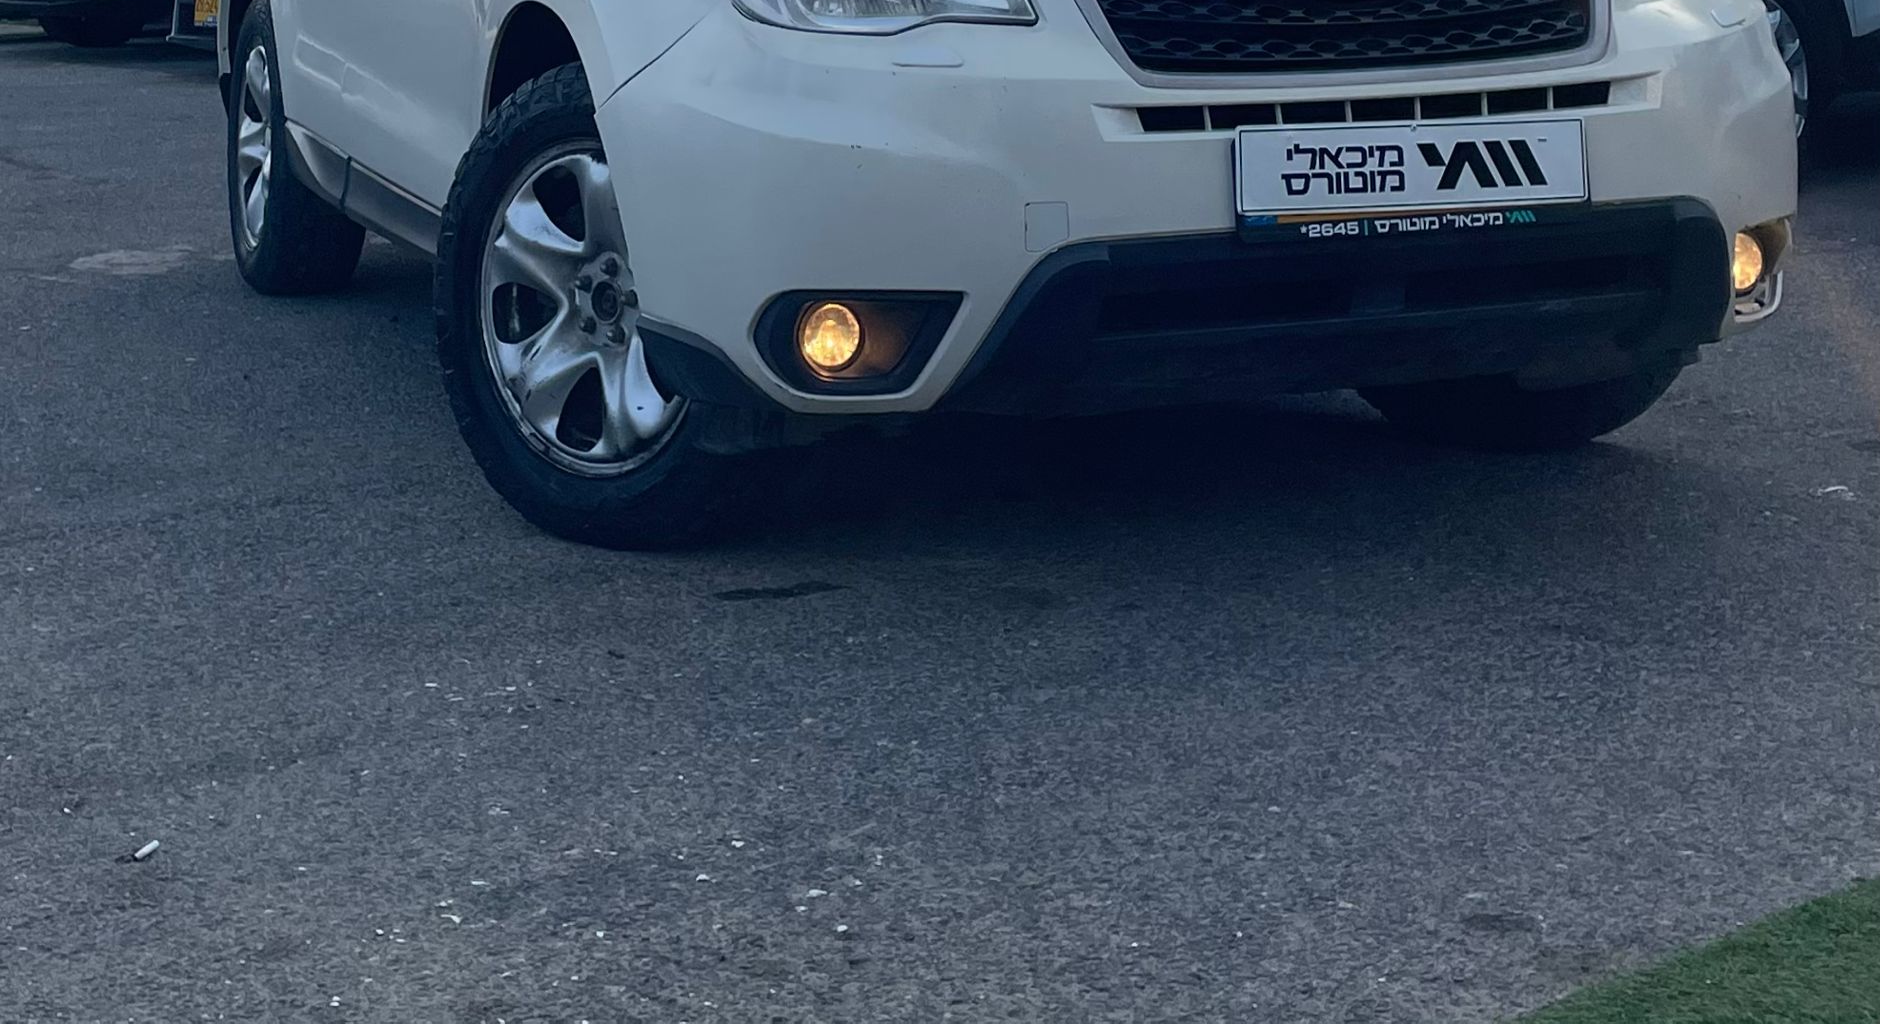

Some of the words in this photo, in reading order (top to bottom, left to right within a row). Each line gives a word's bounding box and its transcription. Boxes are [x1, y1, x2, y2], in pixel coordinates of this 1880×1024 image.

[1286, 143, 1404, 170] מיכאלי
[1281, 170, 1406, 196] מוטורס
[1374, 216, 1439, 233] מוטורס
[1443, 212, 1503, 229] מיכאלי
